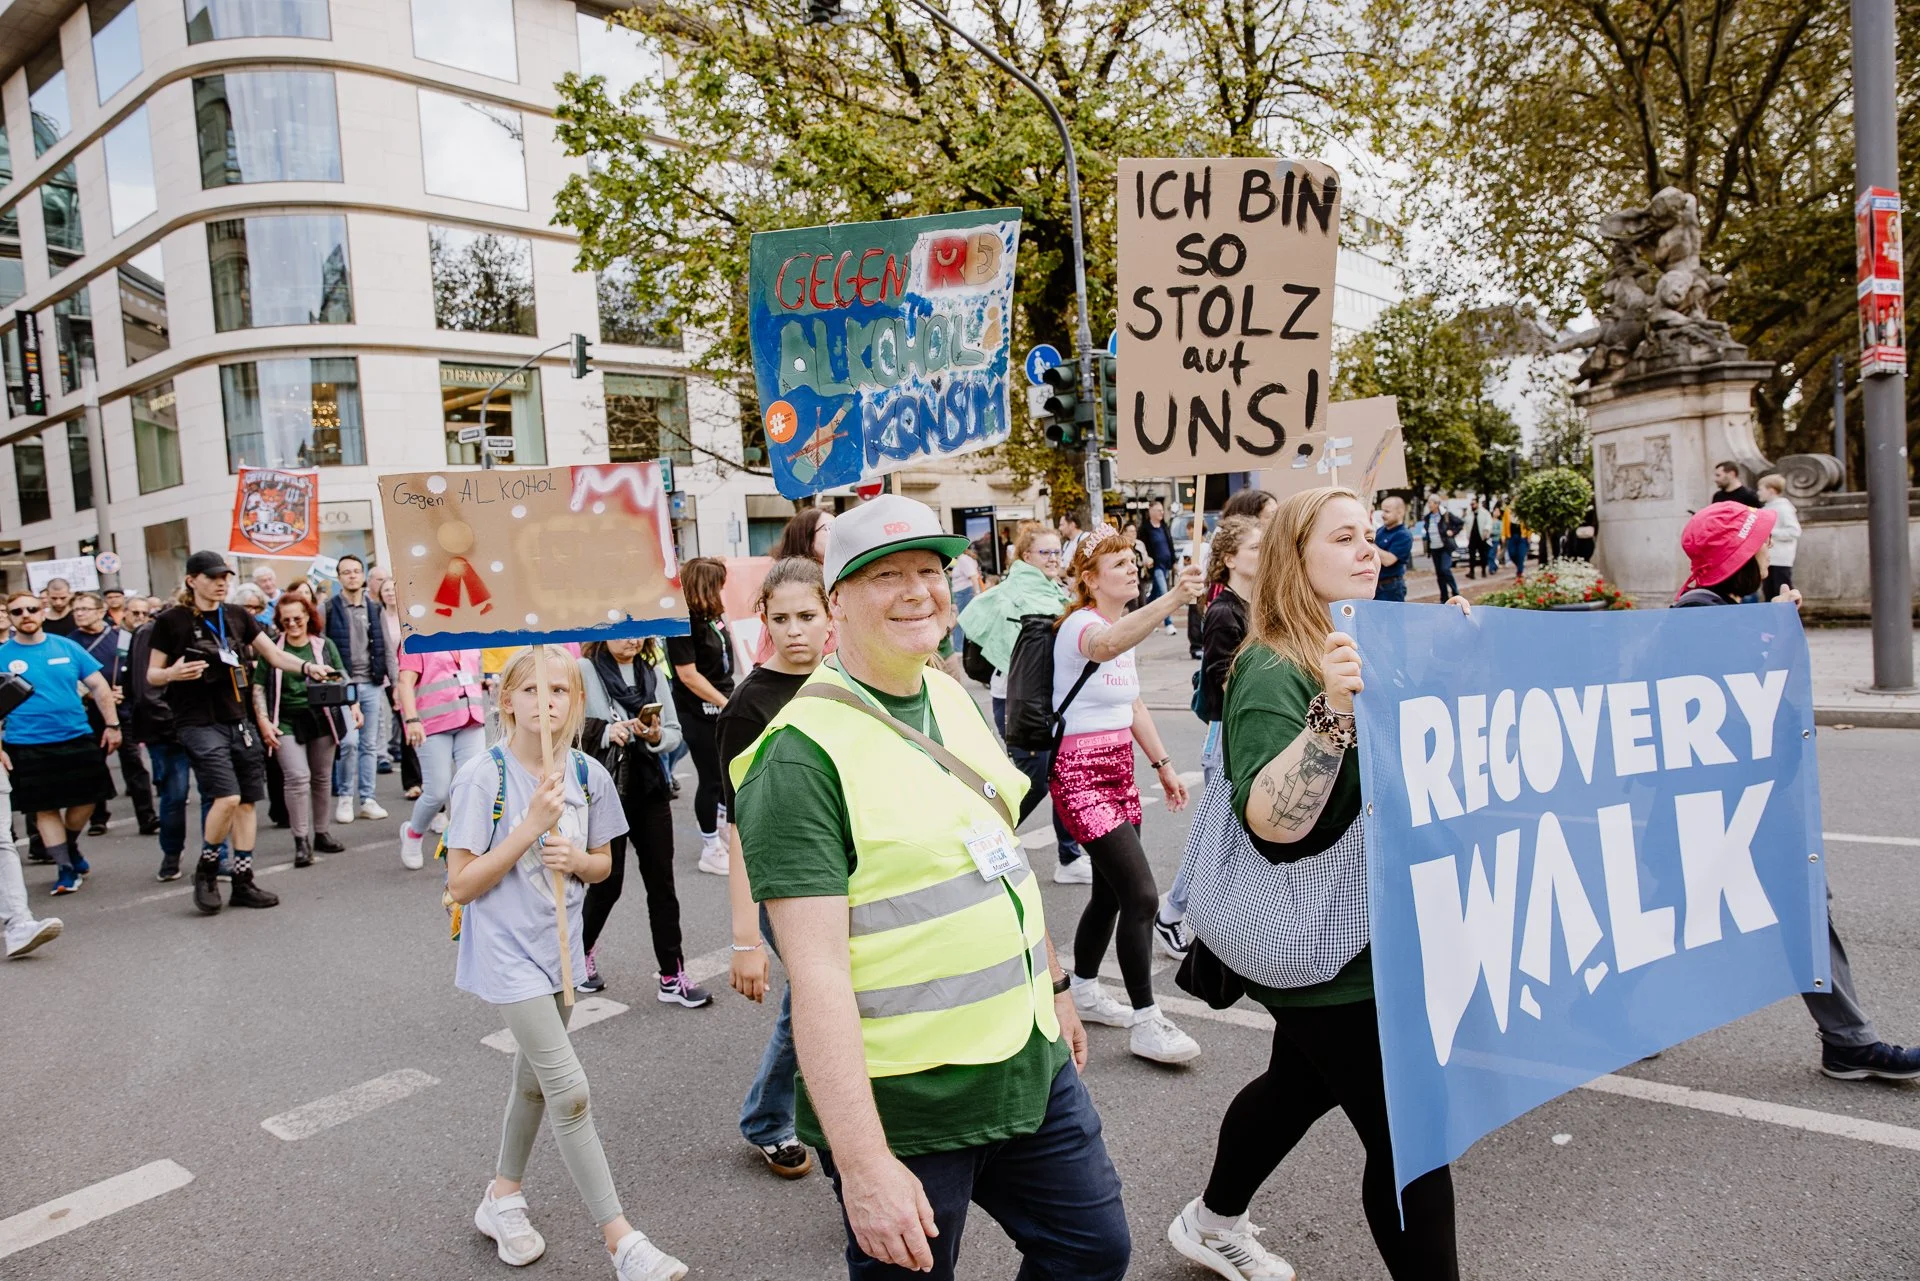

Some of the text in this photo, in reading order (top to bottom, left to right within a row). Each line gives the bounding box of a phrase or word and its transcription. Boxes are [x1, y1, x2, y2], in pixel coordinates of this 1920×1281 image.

[1136, 166, 1337, 236] ICH BIN
[775, 248, 909, 311] GEGEN
[1176, 232, 1248, 277] SO
[1125, 284, 1321, 343] STOLZ
[779, 313, 985, 398] ALKOHOL
[1182, 340, 1250, 387] auf
[861, 379, 1007, 469] KONSUM
[1133, 368, 1320, 458] UNS!
[393, 482, 444, 510] Gegen
[1399, 669, 1789, 827] RECOVERY
[1409, 780, 1779, 1067] WALK
